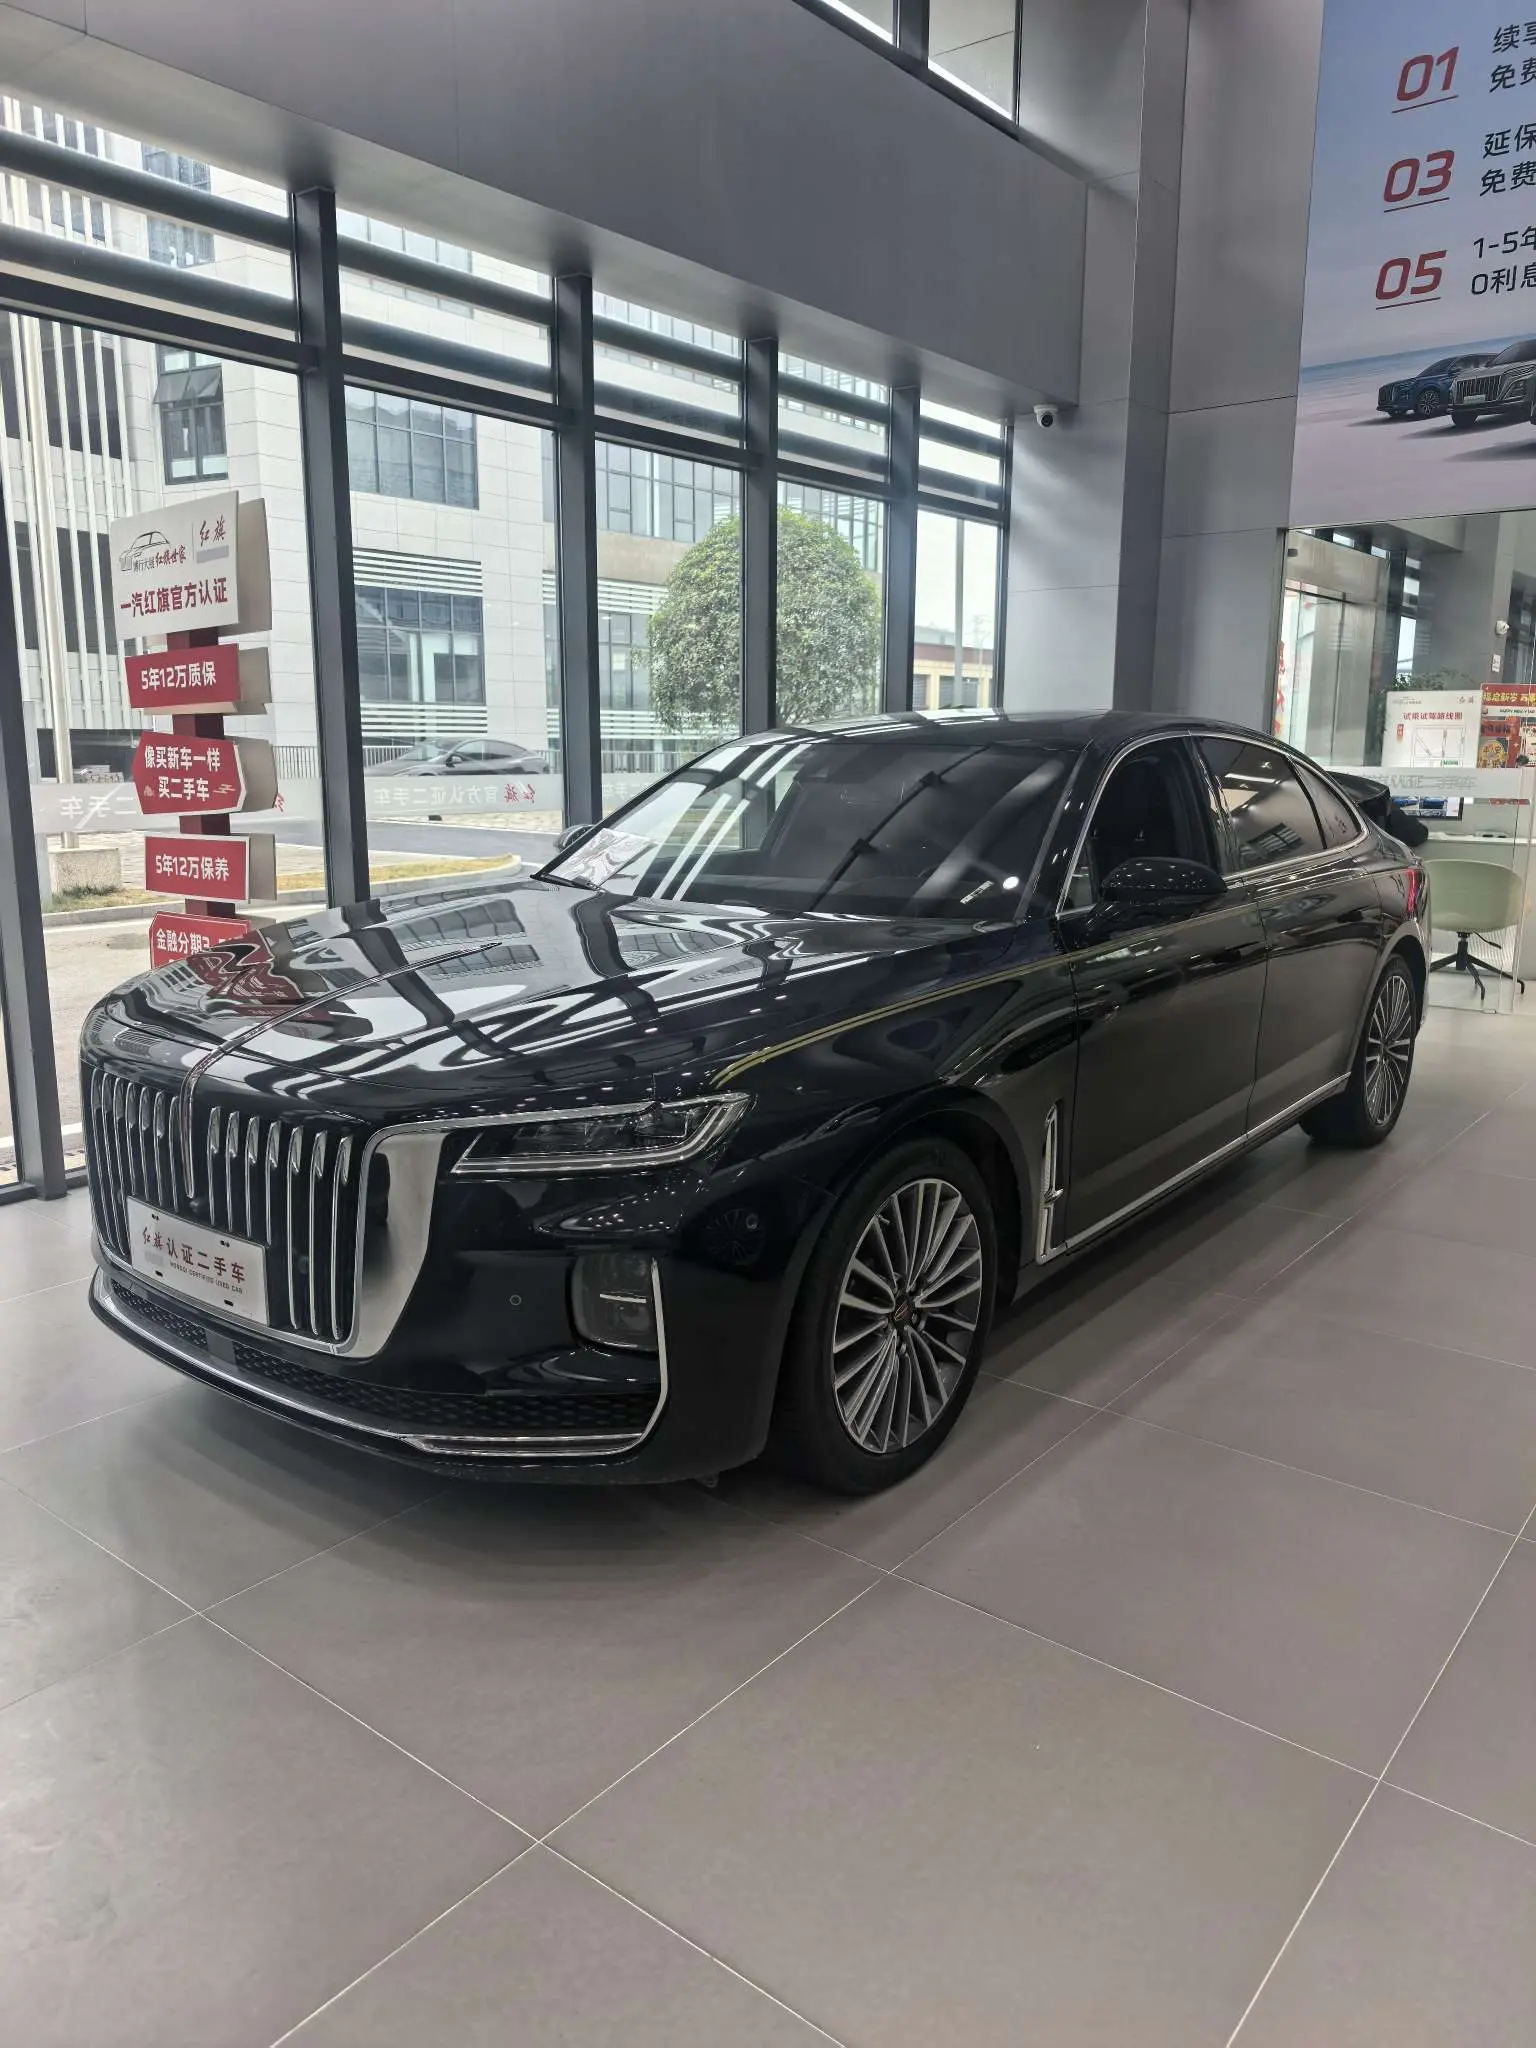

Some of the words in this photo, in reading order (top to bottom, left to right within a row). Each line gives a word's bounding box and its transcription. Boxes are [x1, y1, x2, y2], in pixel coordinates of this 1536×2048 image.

[1397, 46, 1459, 101] 01
[1483, 123, 1536, 159] 延保
[1383, 150, 1455, 203] 03
[1480, 161, 1536, 197] 免费
[1375, 250, 1448, 300] 05
[199, 514, 227, 548] 红旗
[120, 577, 228, 618] 一汽红旗官方认证
[141, 661, 216, 691] 5年12万质保
[144, 745, 221, 772] 像买新车一样
[158, 775, 210, 802] 买二手车
[155, 853, 230, 882] 5年12万保养
